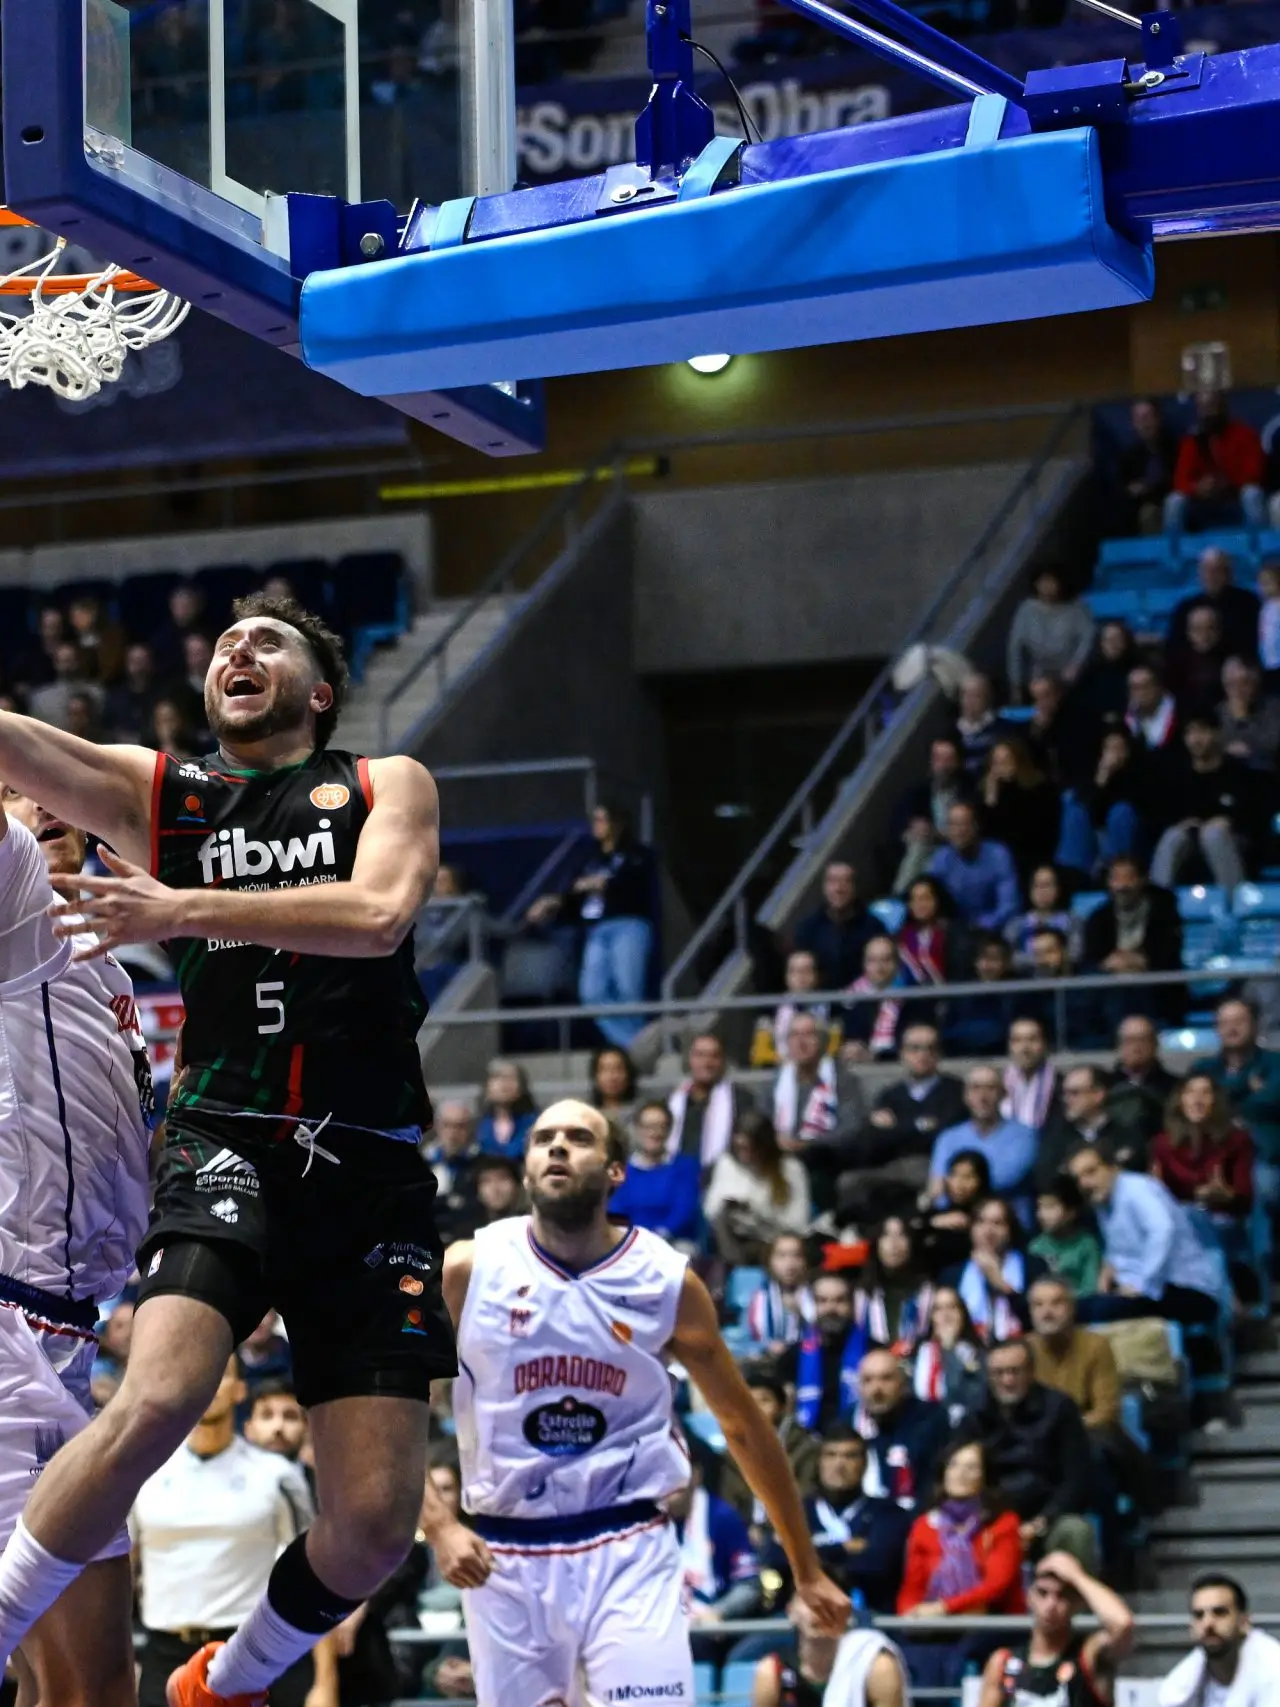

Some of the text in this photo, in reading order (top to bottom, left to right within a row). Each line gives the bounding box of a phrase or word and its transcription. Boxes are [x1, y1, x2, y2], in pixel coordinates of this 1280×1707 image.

[197, 818, 336, 884] fibwi
[255, 981, 285, 1035] 5
[388, 1255, 405, 1265] de
[513, 1355, 627, 1397] OBRADOIRO
